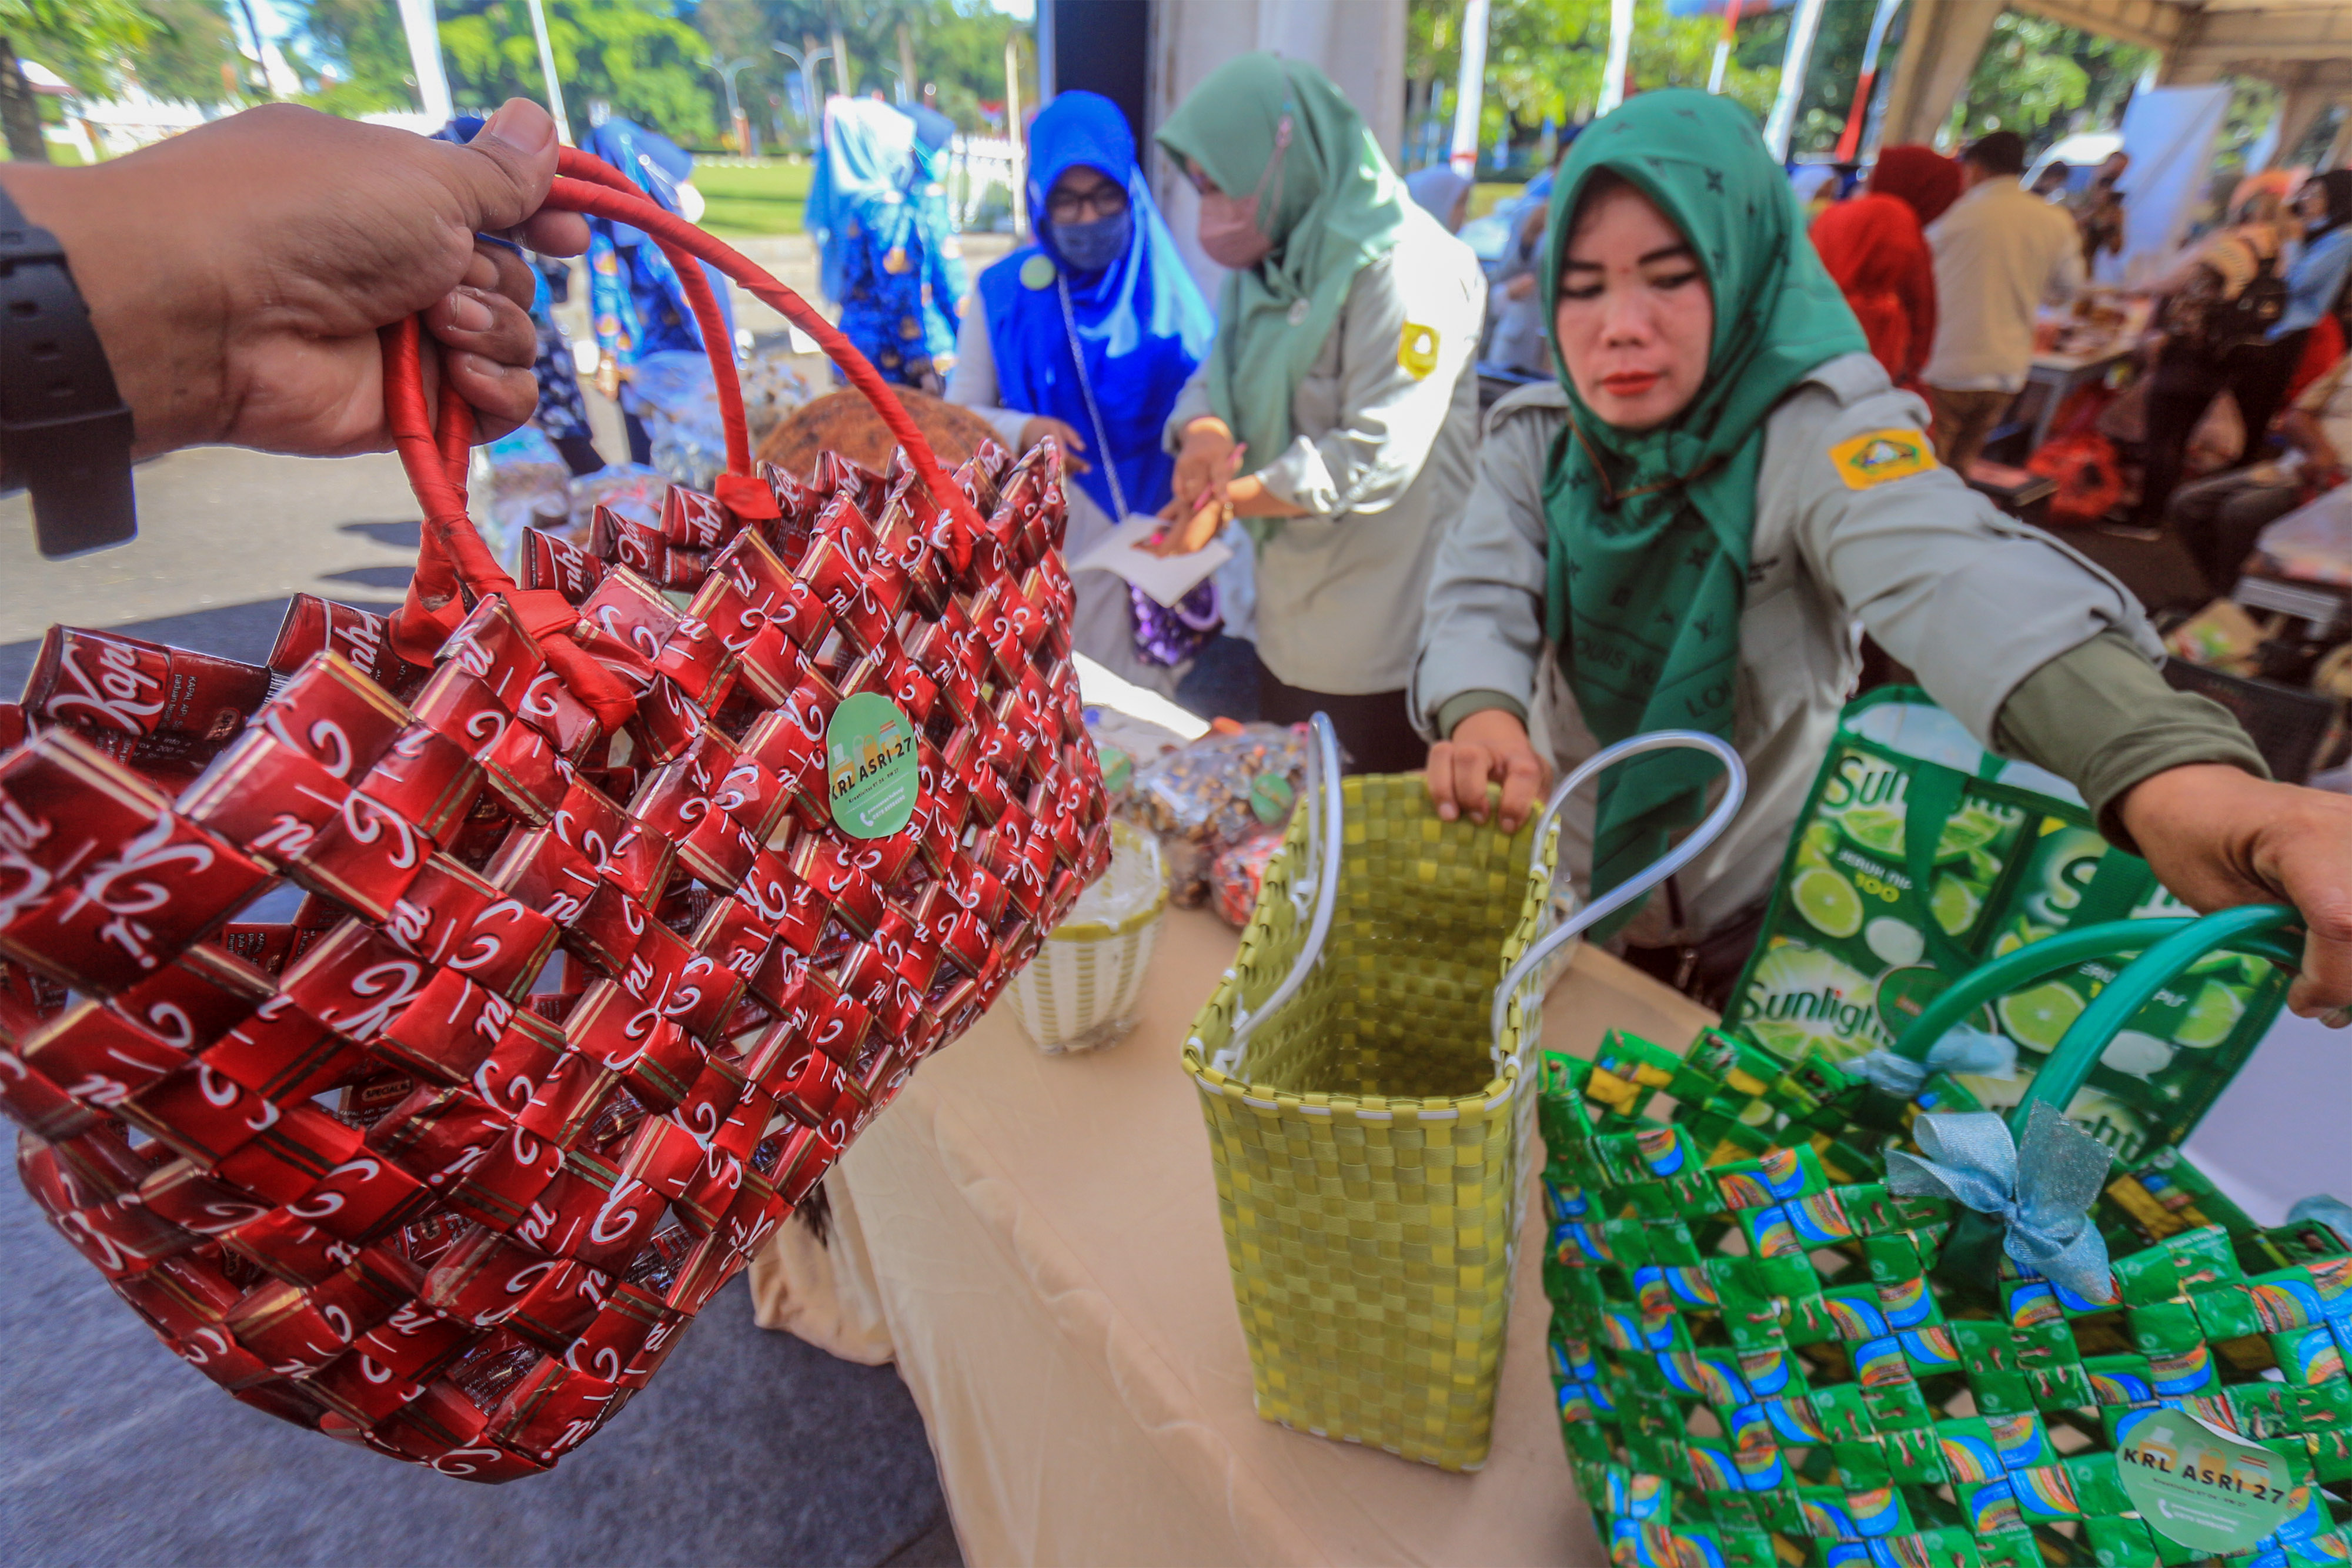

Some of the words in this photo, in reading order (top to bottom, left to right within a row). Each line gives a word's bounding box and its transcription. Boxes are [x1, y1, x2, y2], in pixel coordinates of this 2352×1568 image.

[170, 673, 182, 703] paduan
[183, 676, 197, 701] KAPAL
[859, 750, 893, 782] ASRI
[895, 737, 911, 758] 27
[848, 786, 873, 804] Kreativitas
[2123, 1447, 2172, 1474] KRL
[2181, 1464, 2243, 1495] ASRI
[2252, 1483, 2286, 1505] 27
